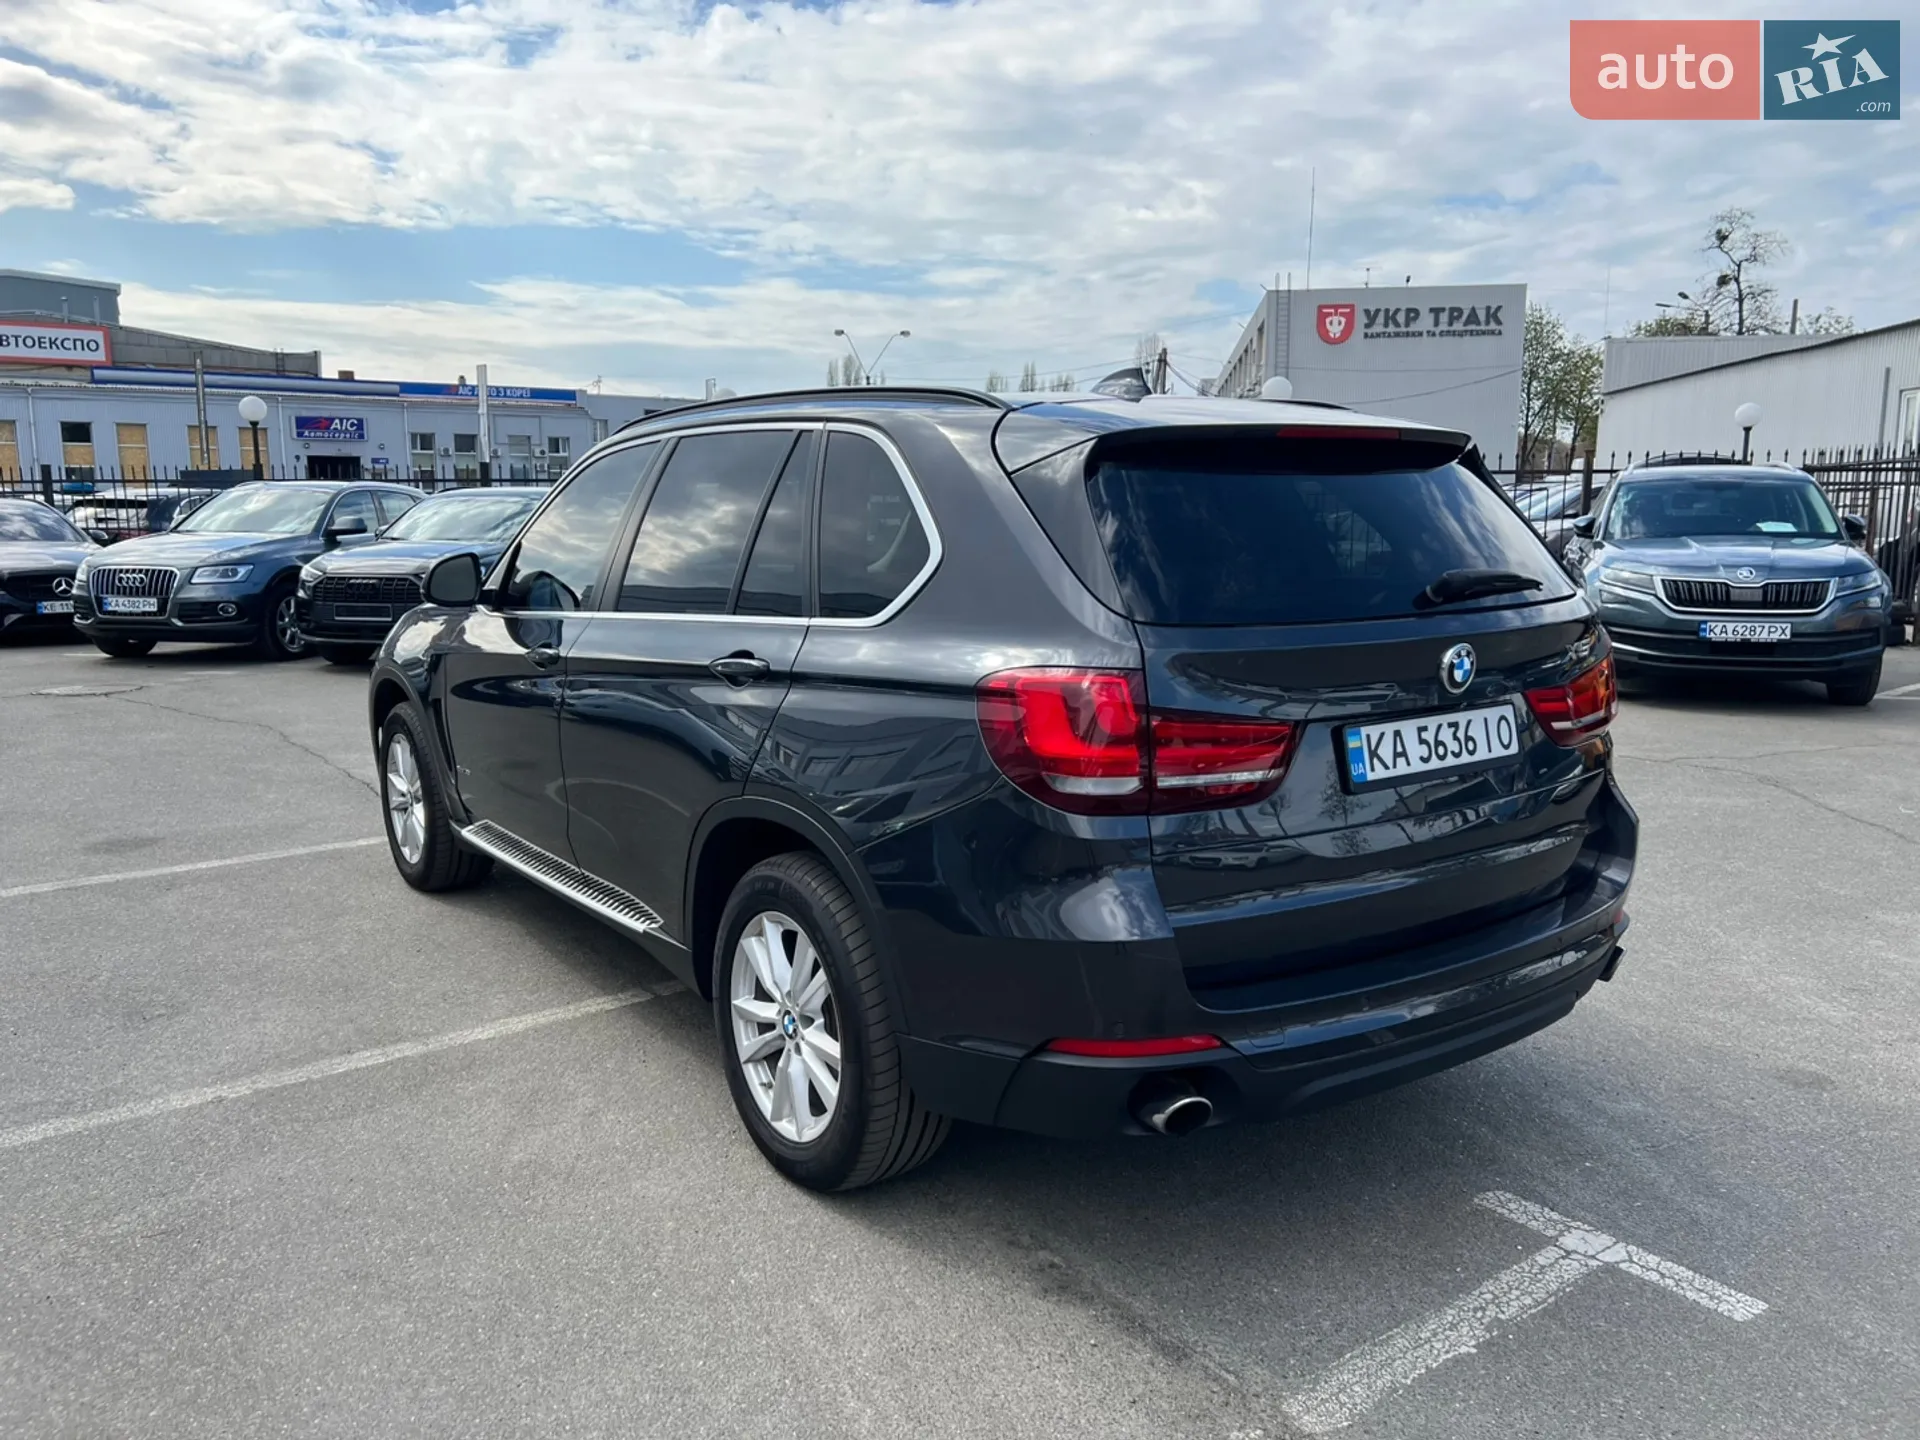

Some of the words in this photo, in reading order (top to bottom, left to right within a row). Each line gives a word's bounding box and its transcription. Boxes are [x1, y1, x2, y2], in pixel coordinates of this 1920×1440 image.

[1363, 307, 1420, 329] УКР
[1429, 305, 1503, 328] ТРАК
[0, 334, 100, 353] ВТОЕКСПО
[1708, 624, 1728, 637] KA
[1731, 624, 1765, 637] 6287
[1767, 625, 1789, 638] PX
[1366, 729, 1411, 772] KA
[1416, 718, 1477, 764] 5636
[1351, 763, 1366, 775] UA
